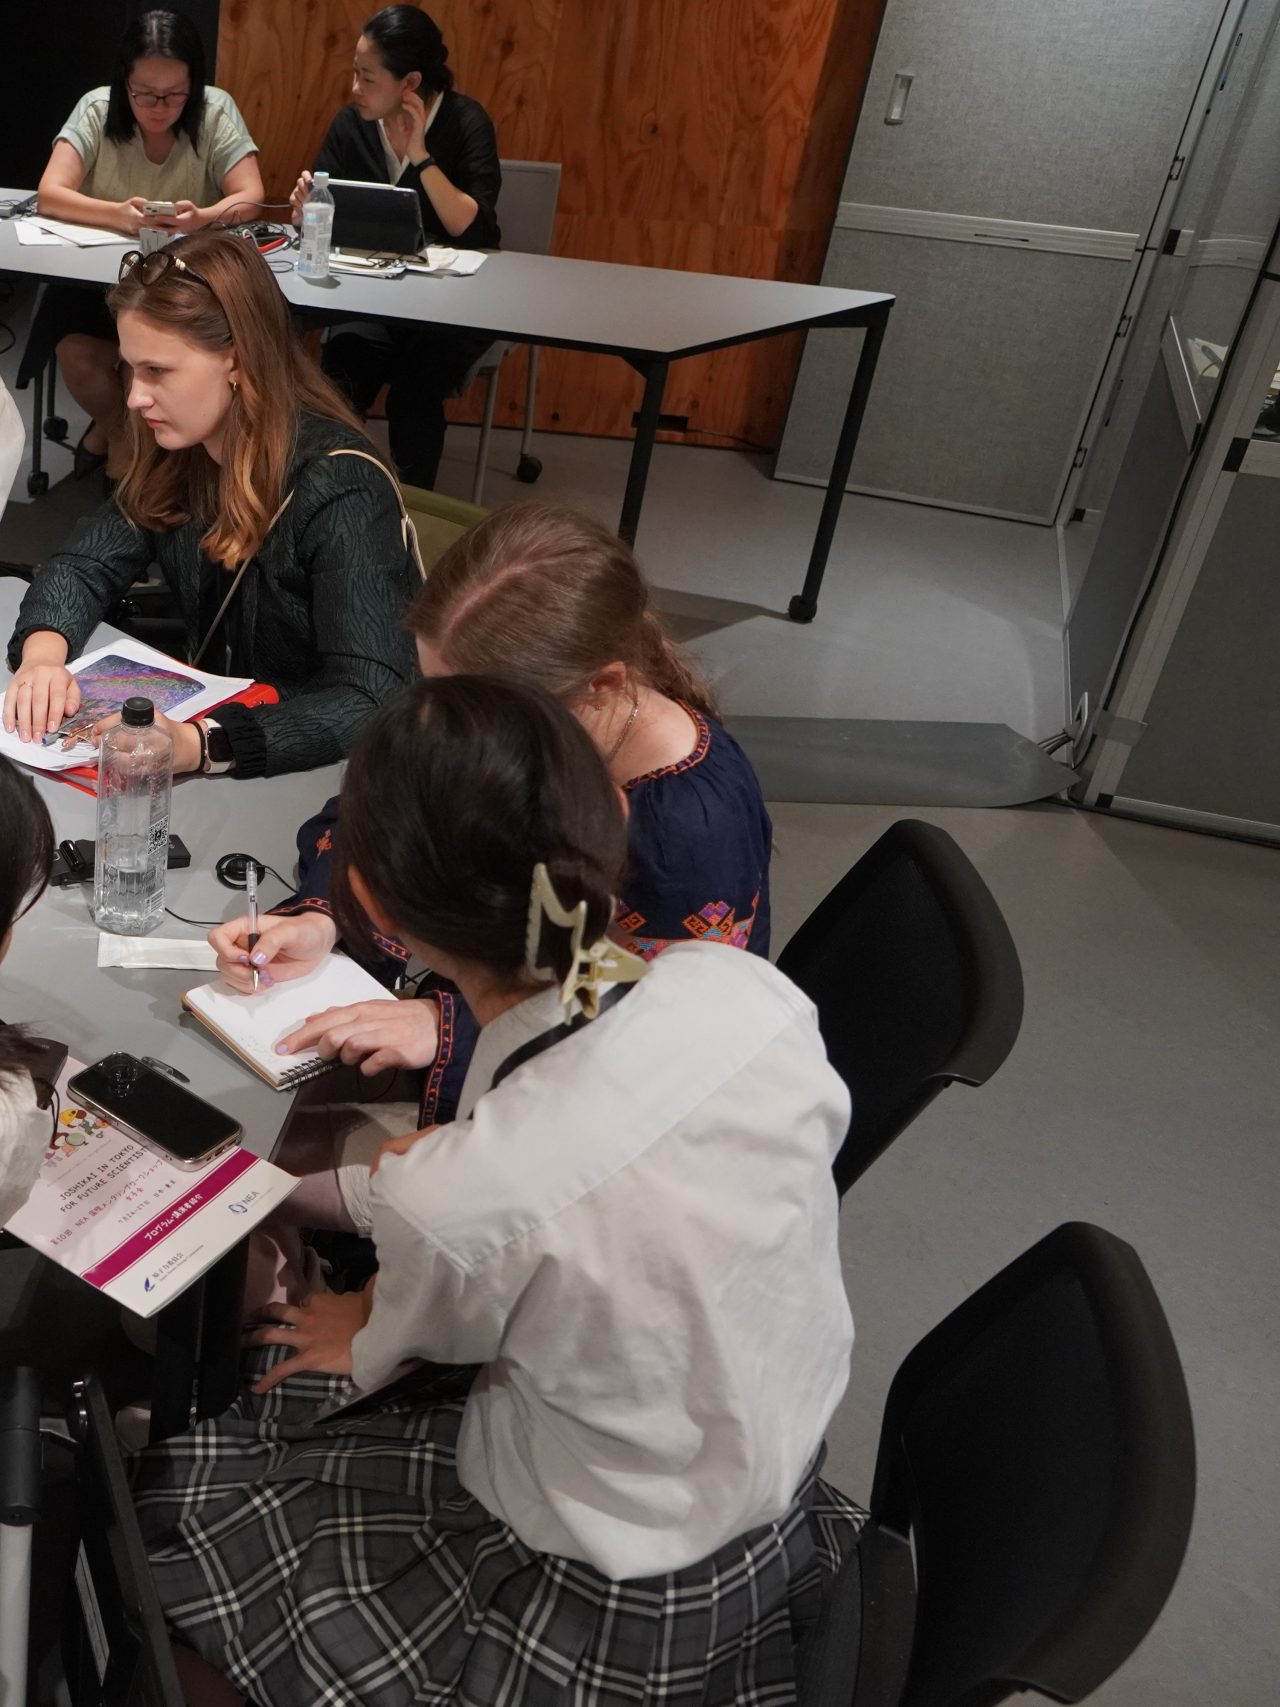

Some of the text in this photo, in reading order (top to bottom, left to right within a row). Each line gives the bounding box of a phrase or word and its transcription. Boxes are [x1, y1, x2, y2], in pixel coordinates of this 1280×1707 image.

[59, 1172, 98, 1200] JOSHIKAI
[95, 1162, 109, 1173] IN
[108, 1144, 134, 1163] TOKYO
[60, 1199, 77, 1213] FOR
[76, 1178, 108, 1201] FUTURE
[106, 1146, 149, 1179] SCIENTIST
[242, 1190, 260, 1205] NEA
[74, 1215, 89, 1228] NEA
